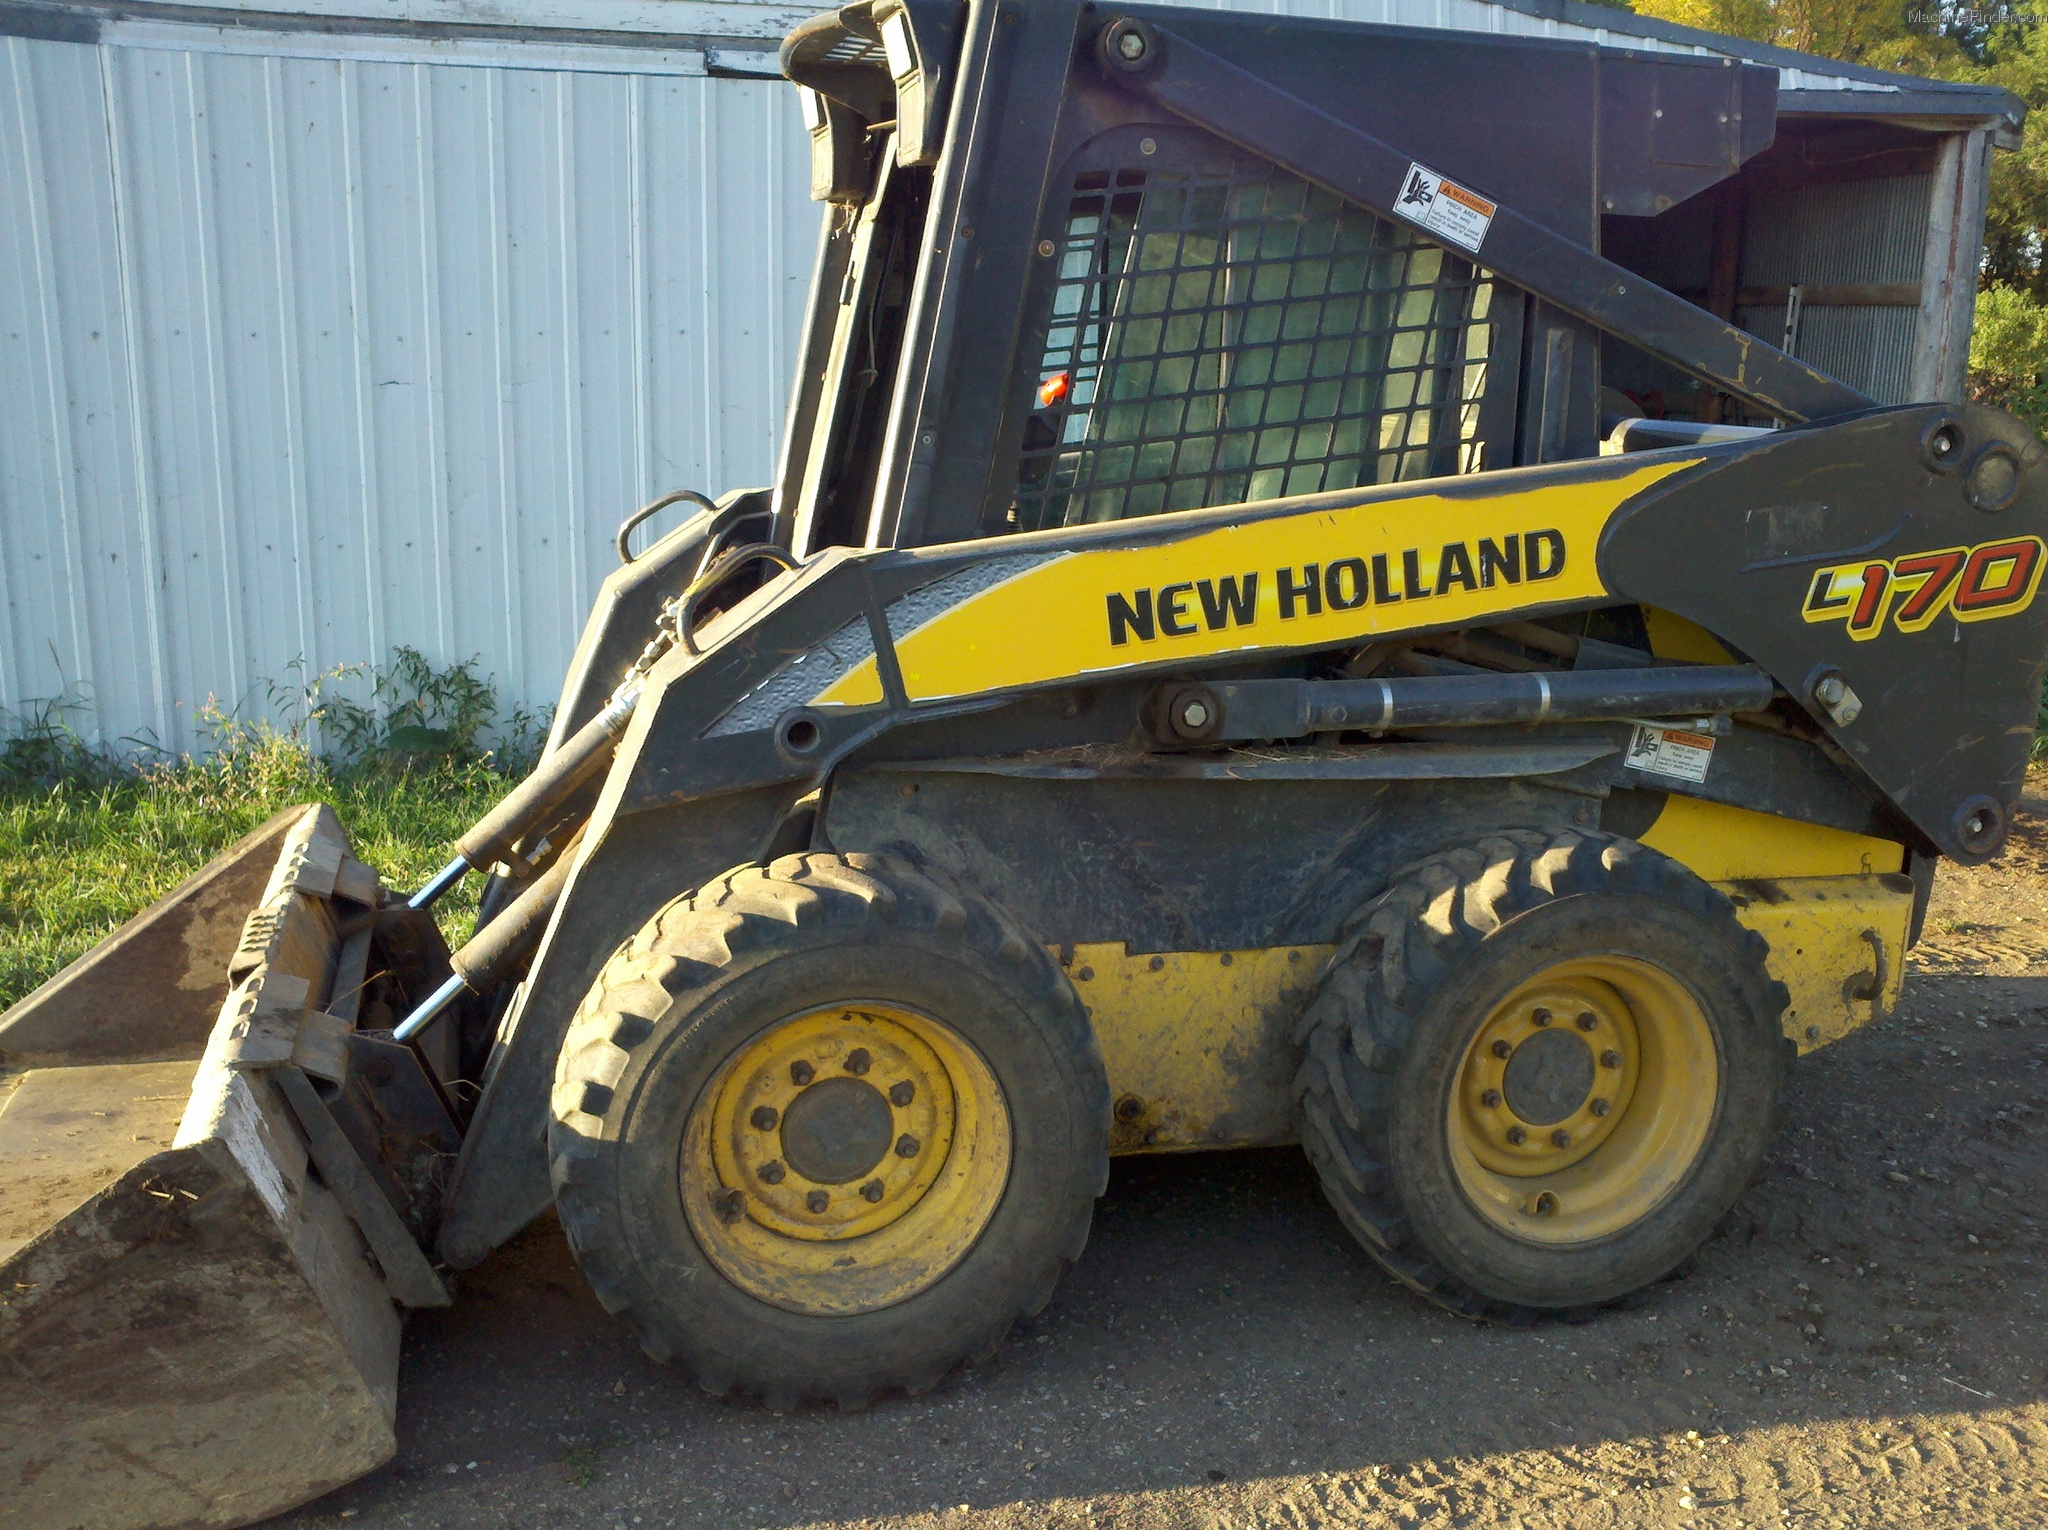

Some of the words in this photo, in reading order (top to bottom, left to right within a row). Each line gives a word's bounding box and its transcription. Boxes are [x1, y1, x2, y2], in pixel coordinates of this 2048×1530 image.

[1452, 191, 1490, 214] WARNING
[1462, 208, 1479, 220] AREA
[1106, 571, 1259, 646] NEW
[1276, 528, 1567, 619] HOLLAND
